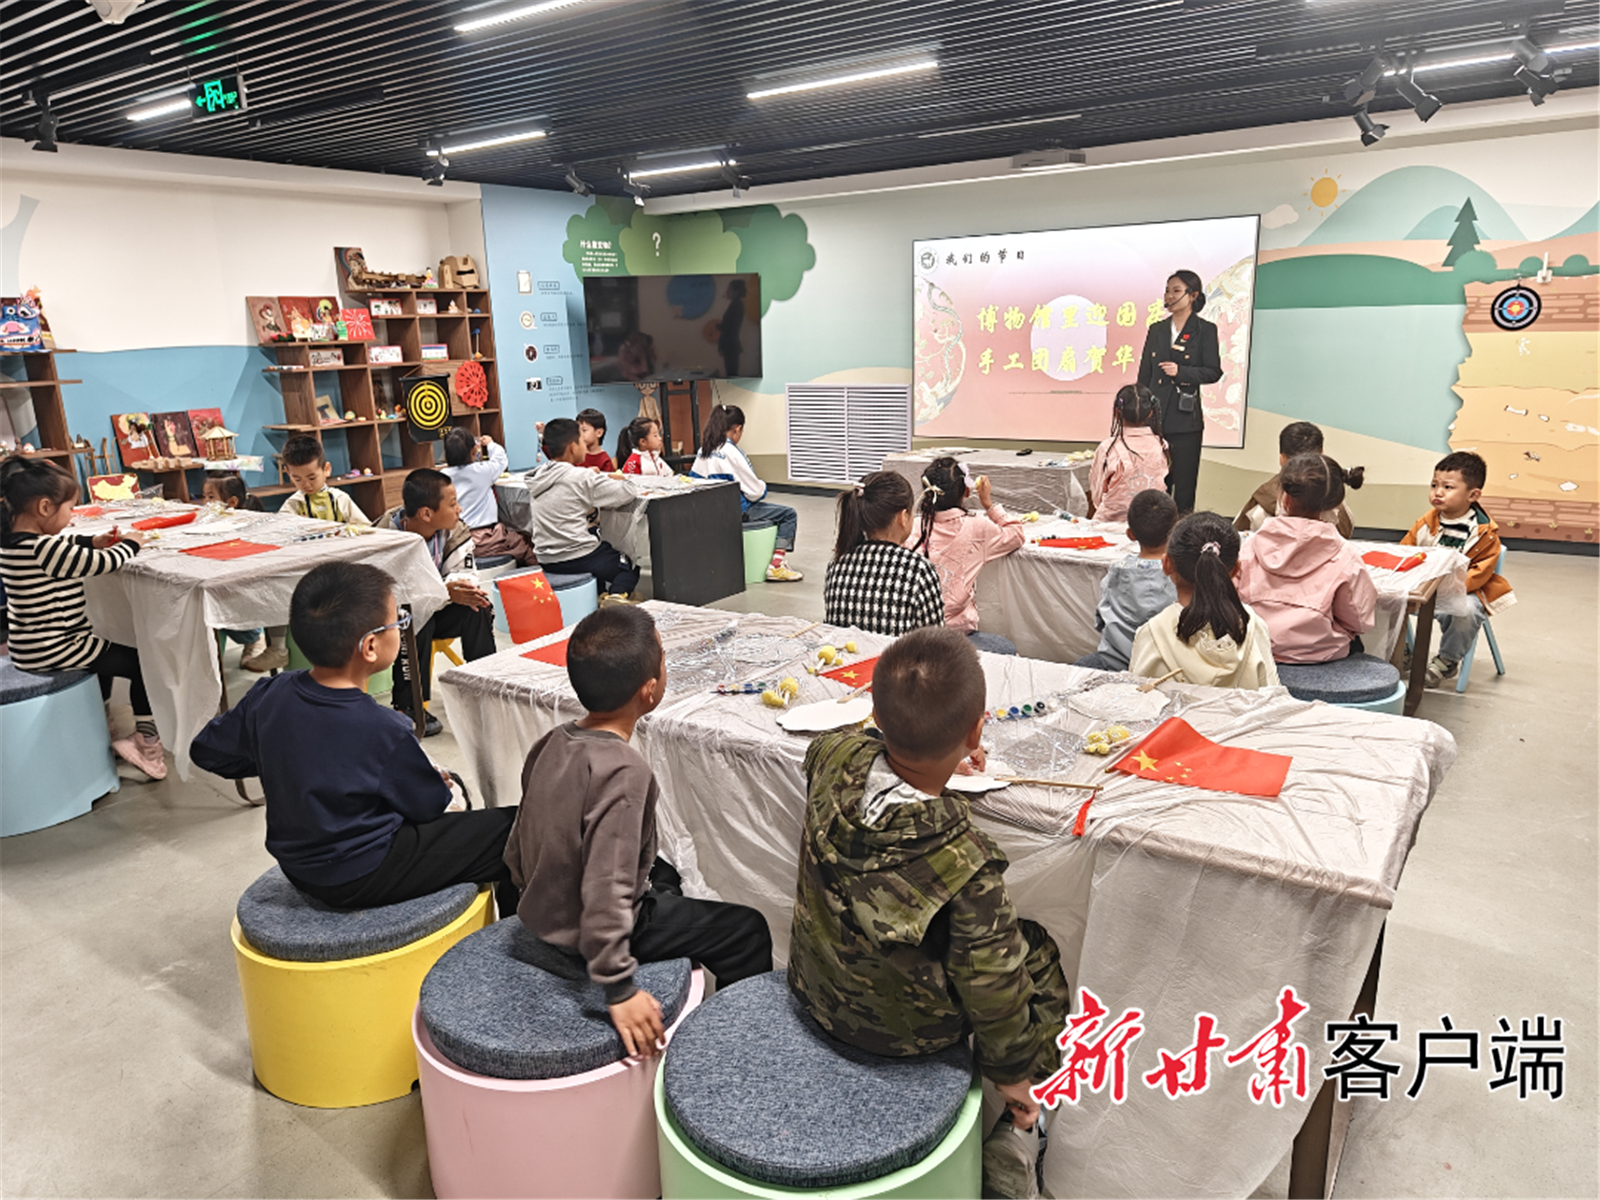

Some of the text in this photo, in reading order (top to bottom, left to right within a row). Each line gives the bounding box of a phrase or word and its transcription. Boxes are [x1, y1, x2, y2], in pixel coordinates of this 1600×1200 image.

[946, 248, 1025, 266] 我们的节日
